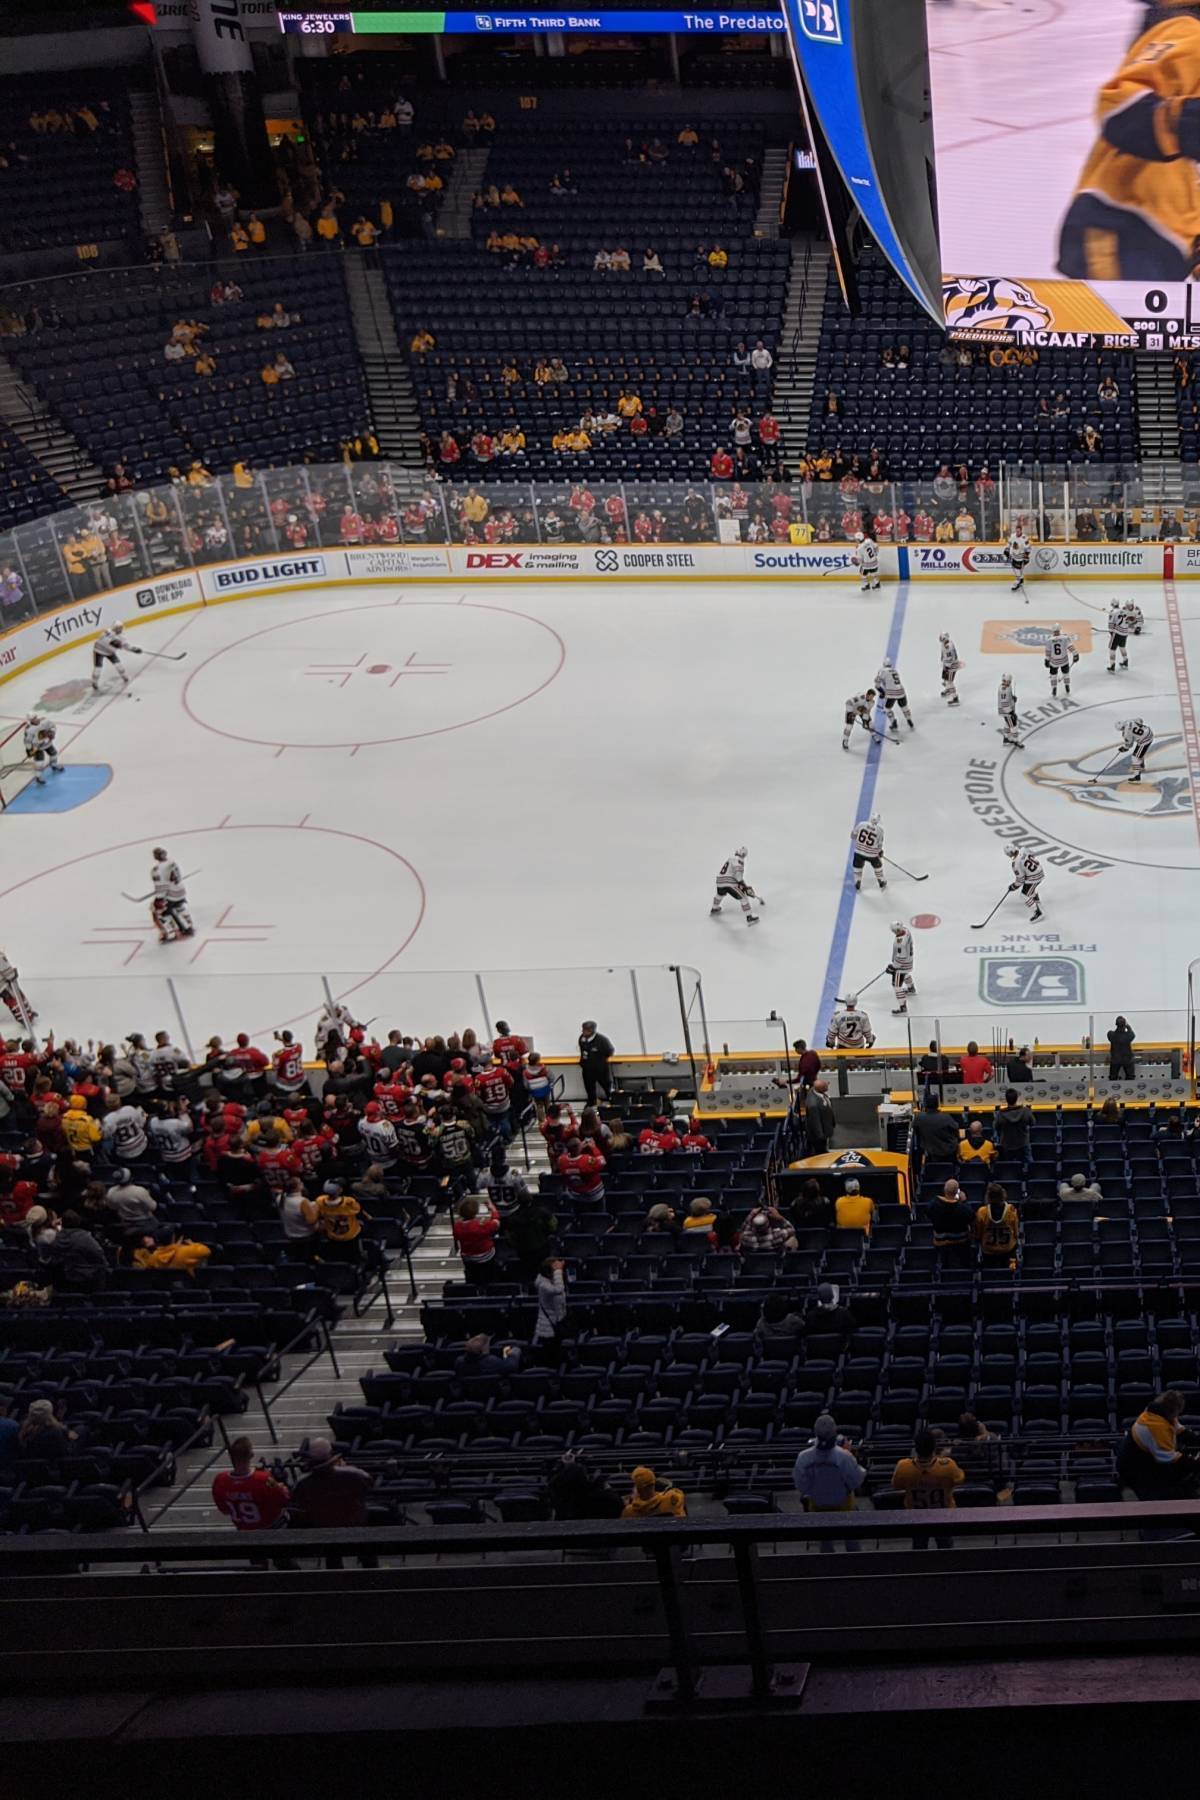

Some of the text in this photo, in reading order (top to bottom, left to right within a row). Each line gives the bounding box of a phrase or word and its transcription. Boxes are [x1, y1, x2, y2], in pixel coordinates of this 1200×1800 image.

[301, 22, 335, 33] 6:30
[495, 18, 600, 28] FIFTH THIRD BANK
[684, 15, 714, 30] The
[1145, 289, 1169, 314] 0
[1134, 320, 1178, 333] SOG 0
[1022, 332, 1089, 348] NCAAF
[1104, 335, 1140, 348] RICE
[1150, 336, 1160, 348] 31
[466, 554, 524, 569] DEX
[524, 561, 579, 570] & mailing
[529, 553, 578, 562] imaging
[624, 554, 695, 568] COOPER STEEL
[754, 552, 850, 568] Southwest
[216, 560, 320, 587] BUD LIGHT
[155, 578, 192, 594] DOWNLOAD
[44, 607, 103, 642] xfinity
[1054, 644, 1062, 656] 6
[964, 758, 1115, 873] BRIDGESTONE
[858, 830, 877, 847] 65
[1001, 934, 1060, 942] BANK
[964, 944, 1098, 954] FIFTH THIRD
[4, 1068, 26, 1084] 20
[485, 1083, 507, 1101] 19
[114, 1124, 138, 1142] 81
[443, 1140, 468, 1162] 50
[228, 1502, 260, 1523] 19
